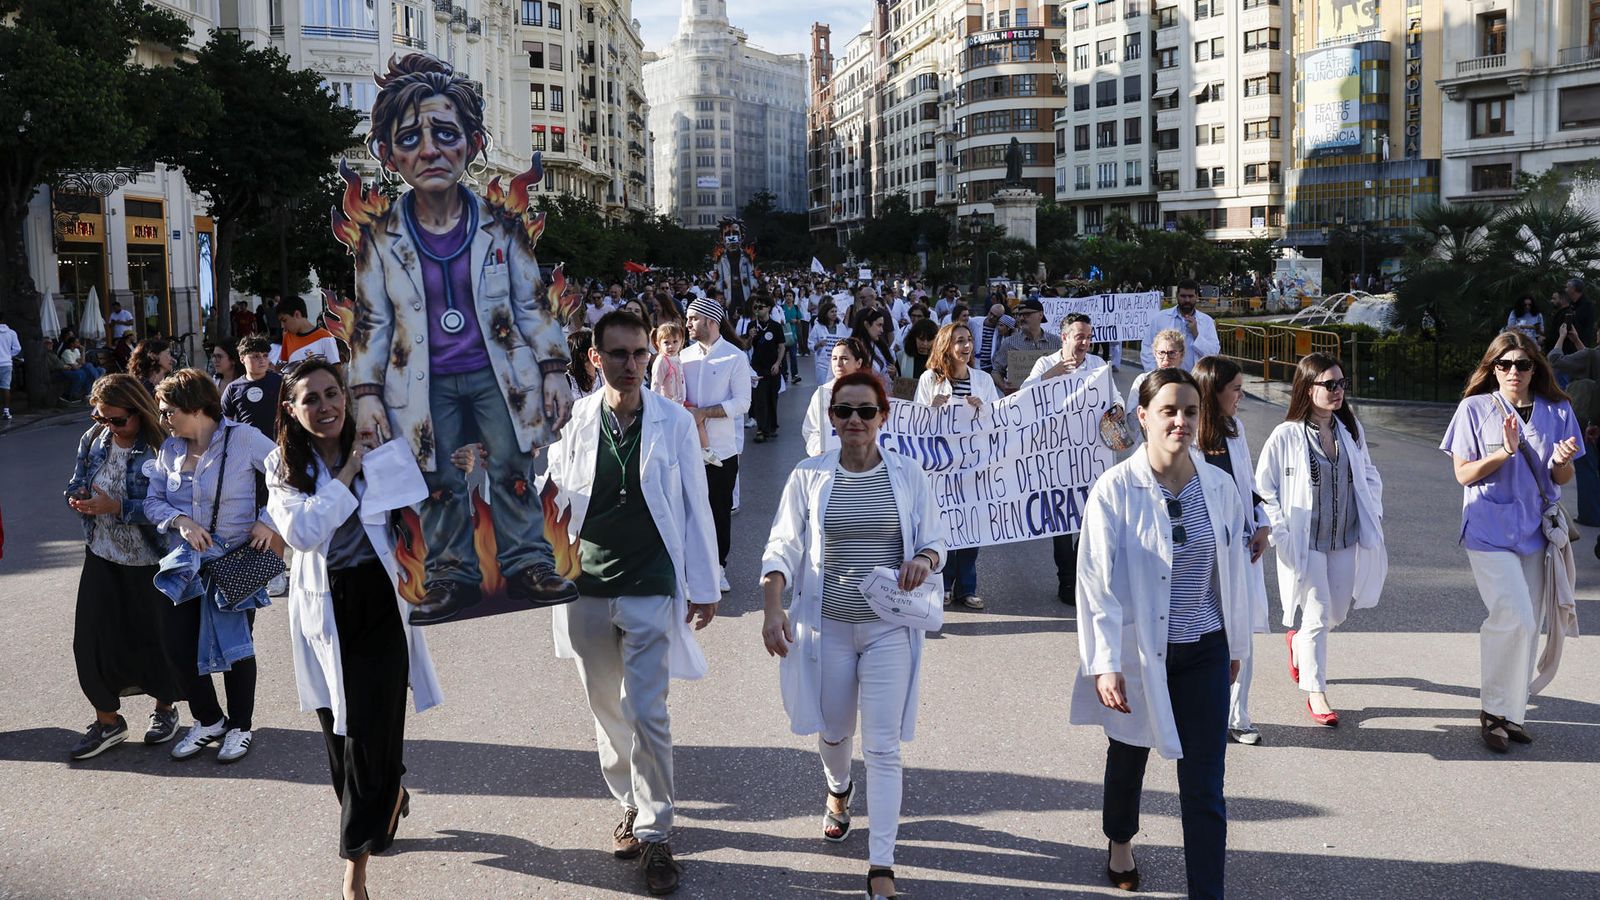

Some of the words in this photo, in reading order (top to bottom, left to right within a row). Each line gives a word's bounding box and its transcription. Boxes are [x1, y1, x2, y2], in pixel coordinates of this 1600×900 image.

[973, 32, 1000, 44] CASUAL
[1001, 30, 1040, 40] HOTELES
[1326, 49, 1338, 60] EL
[1314, 56, 1350, 71] TEATRE
[1306, 66, 1359, 83] FUNCIONA
[1406, 17, 1421, 152] FILMOTECA
[1314, 100, 1350, 114] TEATRE
[1315, 111, 1349, 124] RIALTO
[1325, 122, 1338, 133] DE
[1101, 294, 1115, 313] TU
[1117, 295, 1132, 310] VIDA
[1091, 325, 1118, 341] ATUTO
[885, 400, 964, 437] TIÉNDOME
[970, 411, 983, 433] A
[991, 395, 1023, 429] LOS
[959, 433, 981, 470] ES
[1016, 409, 1097, 460] TRABAJO
[928, 472, 966, 508] GAN
[1015, 445, 1106, 494] DERECHOS
[940, 506, 981, 547] CERLO
